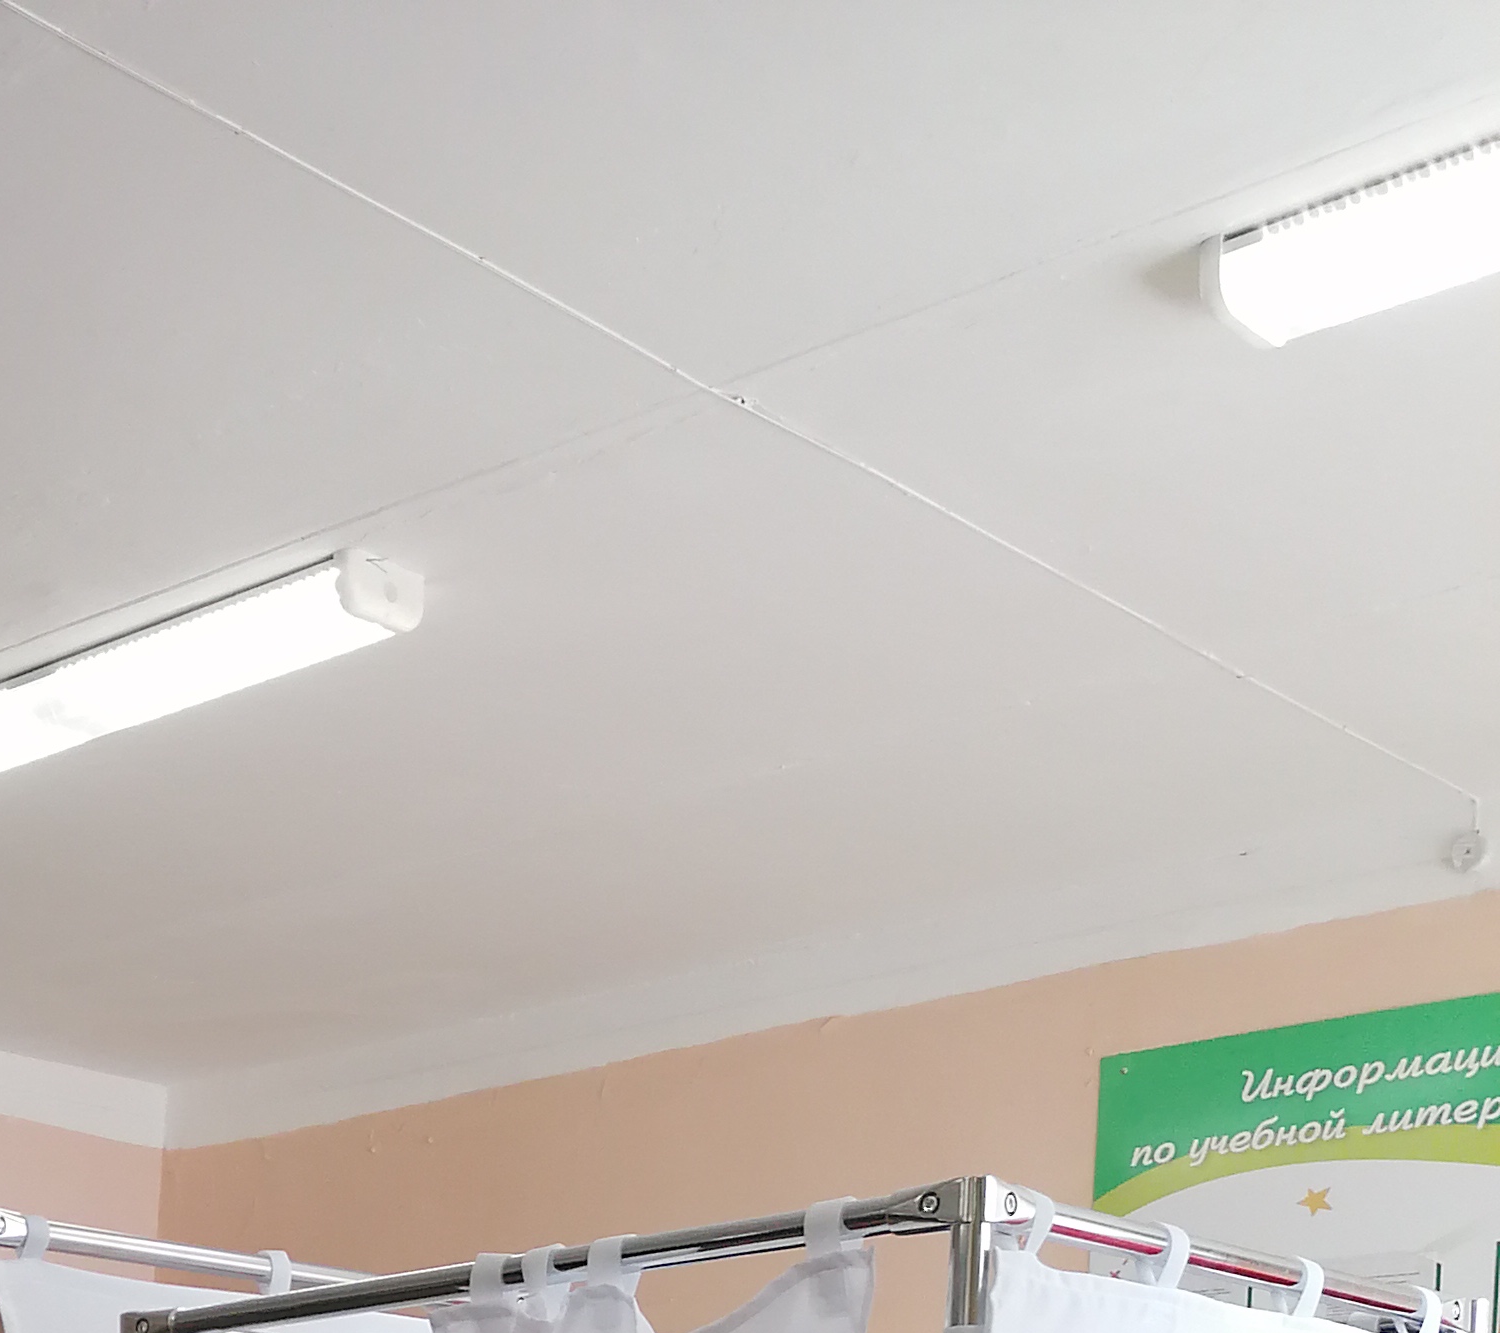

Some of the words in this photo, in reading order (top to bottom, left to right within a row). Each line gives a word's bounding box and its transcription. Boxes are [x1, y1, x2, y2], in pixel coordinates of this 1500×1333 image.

[1129, 1141, 1176, 1167] по
[1188, 1107, 1346, 1166] учебной
[1361, 1096, 1500, 1136] литер
